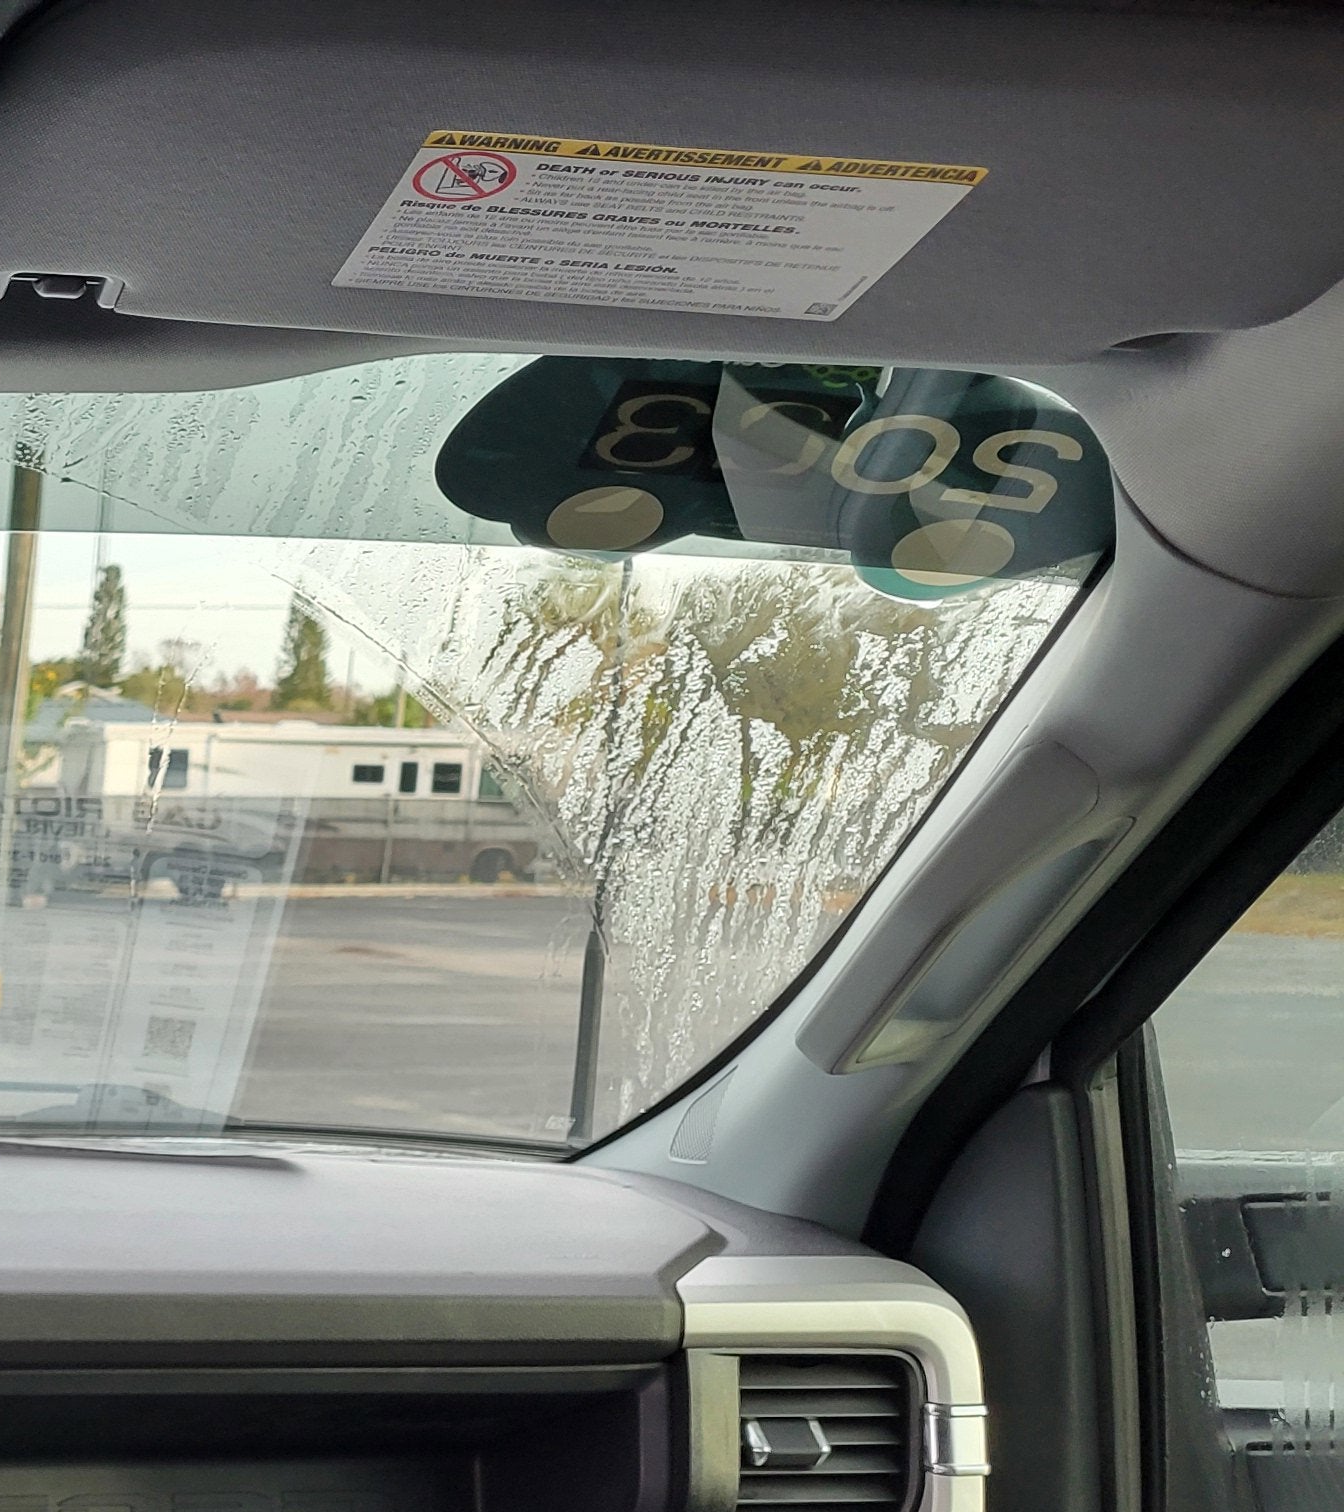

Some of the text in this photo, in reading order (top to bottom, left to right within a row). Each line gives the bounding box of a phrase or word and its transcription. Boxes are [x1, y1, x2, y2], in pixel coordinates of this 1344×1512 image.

[459, 134, 980, 182] WARNING AVERTISSEMENT ADVERTENCIA
[536, 163, 596, 175] DEATH
[622, 169, 702, 182] SERIOUS
[704, 175, 771, 186] INJURY
[773, 181, 805, 189] can
[809, 183, 863, 193] occur.
[399, 200, 456, 211] Risque
[461, 203, 482, 212] de
[486, 205, 589, 220] BLESSURES
[592, 213, 661, 226] GRAVES
[689, 220, 802, 235] MORTELLES.
[368, 246, 441, 258] PELIGRO
[445, 250, 465, 260] de
[469, 252, 543, 266] MUERTE
[558, 259, 609, 270] SERIA
